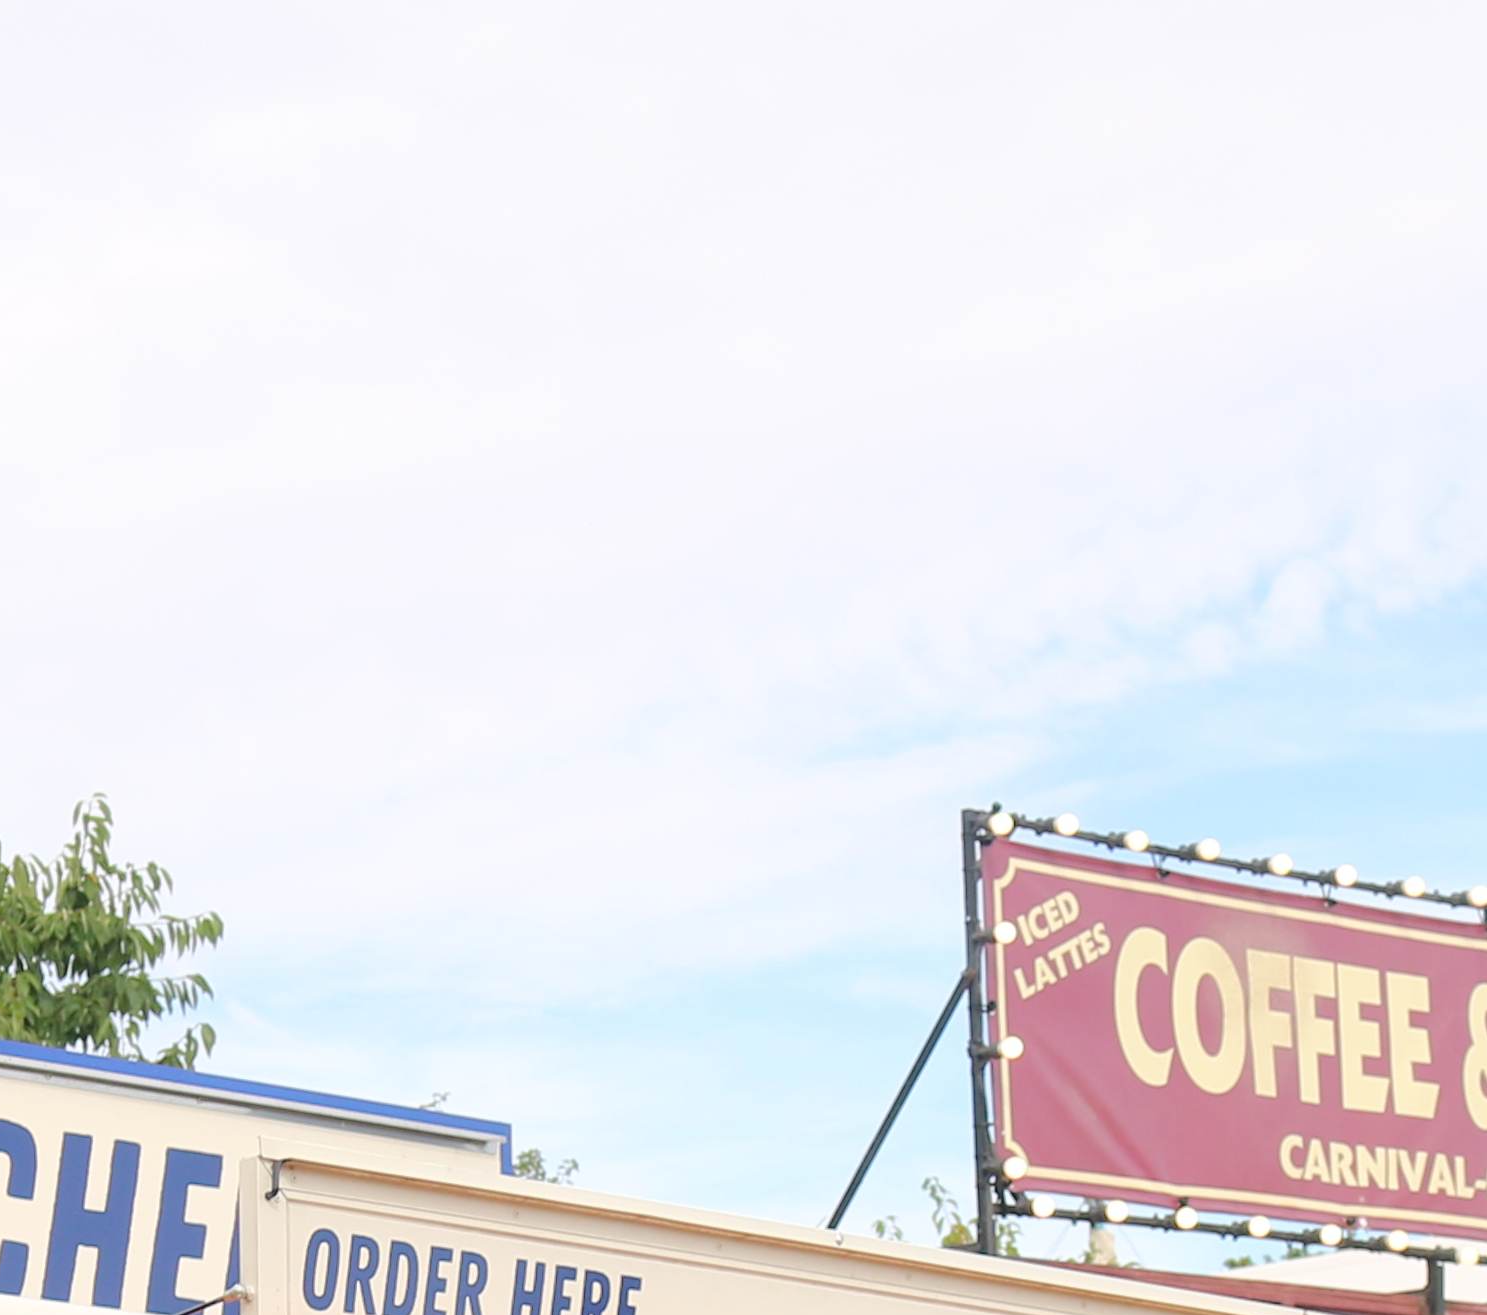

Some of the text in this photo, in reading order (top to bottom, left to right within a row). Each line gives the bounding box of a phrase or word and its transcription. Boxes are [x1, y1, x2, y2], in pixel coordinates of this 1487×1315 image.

[1017, 890, 1080, 947] ICED
[1013, 921, 1112, 1000] LATTES
[1113, 927, 1441, 1120] COFFEE
